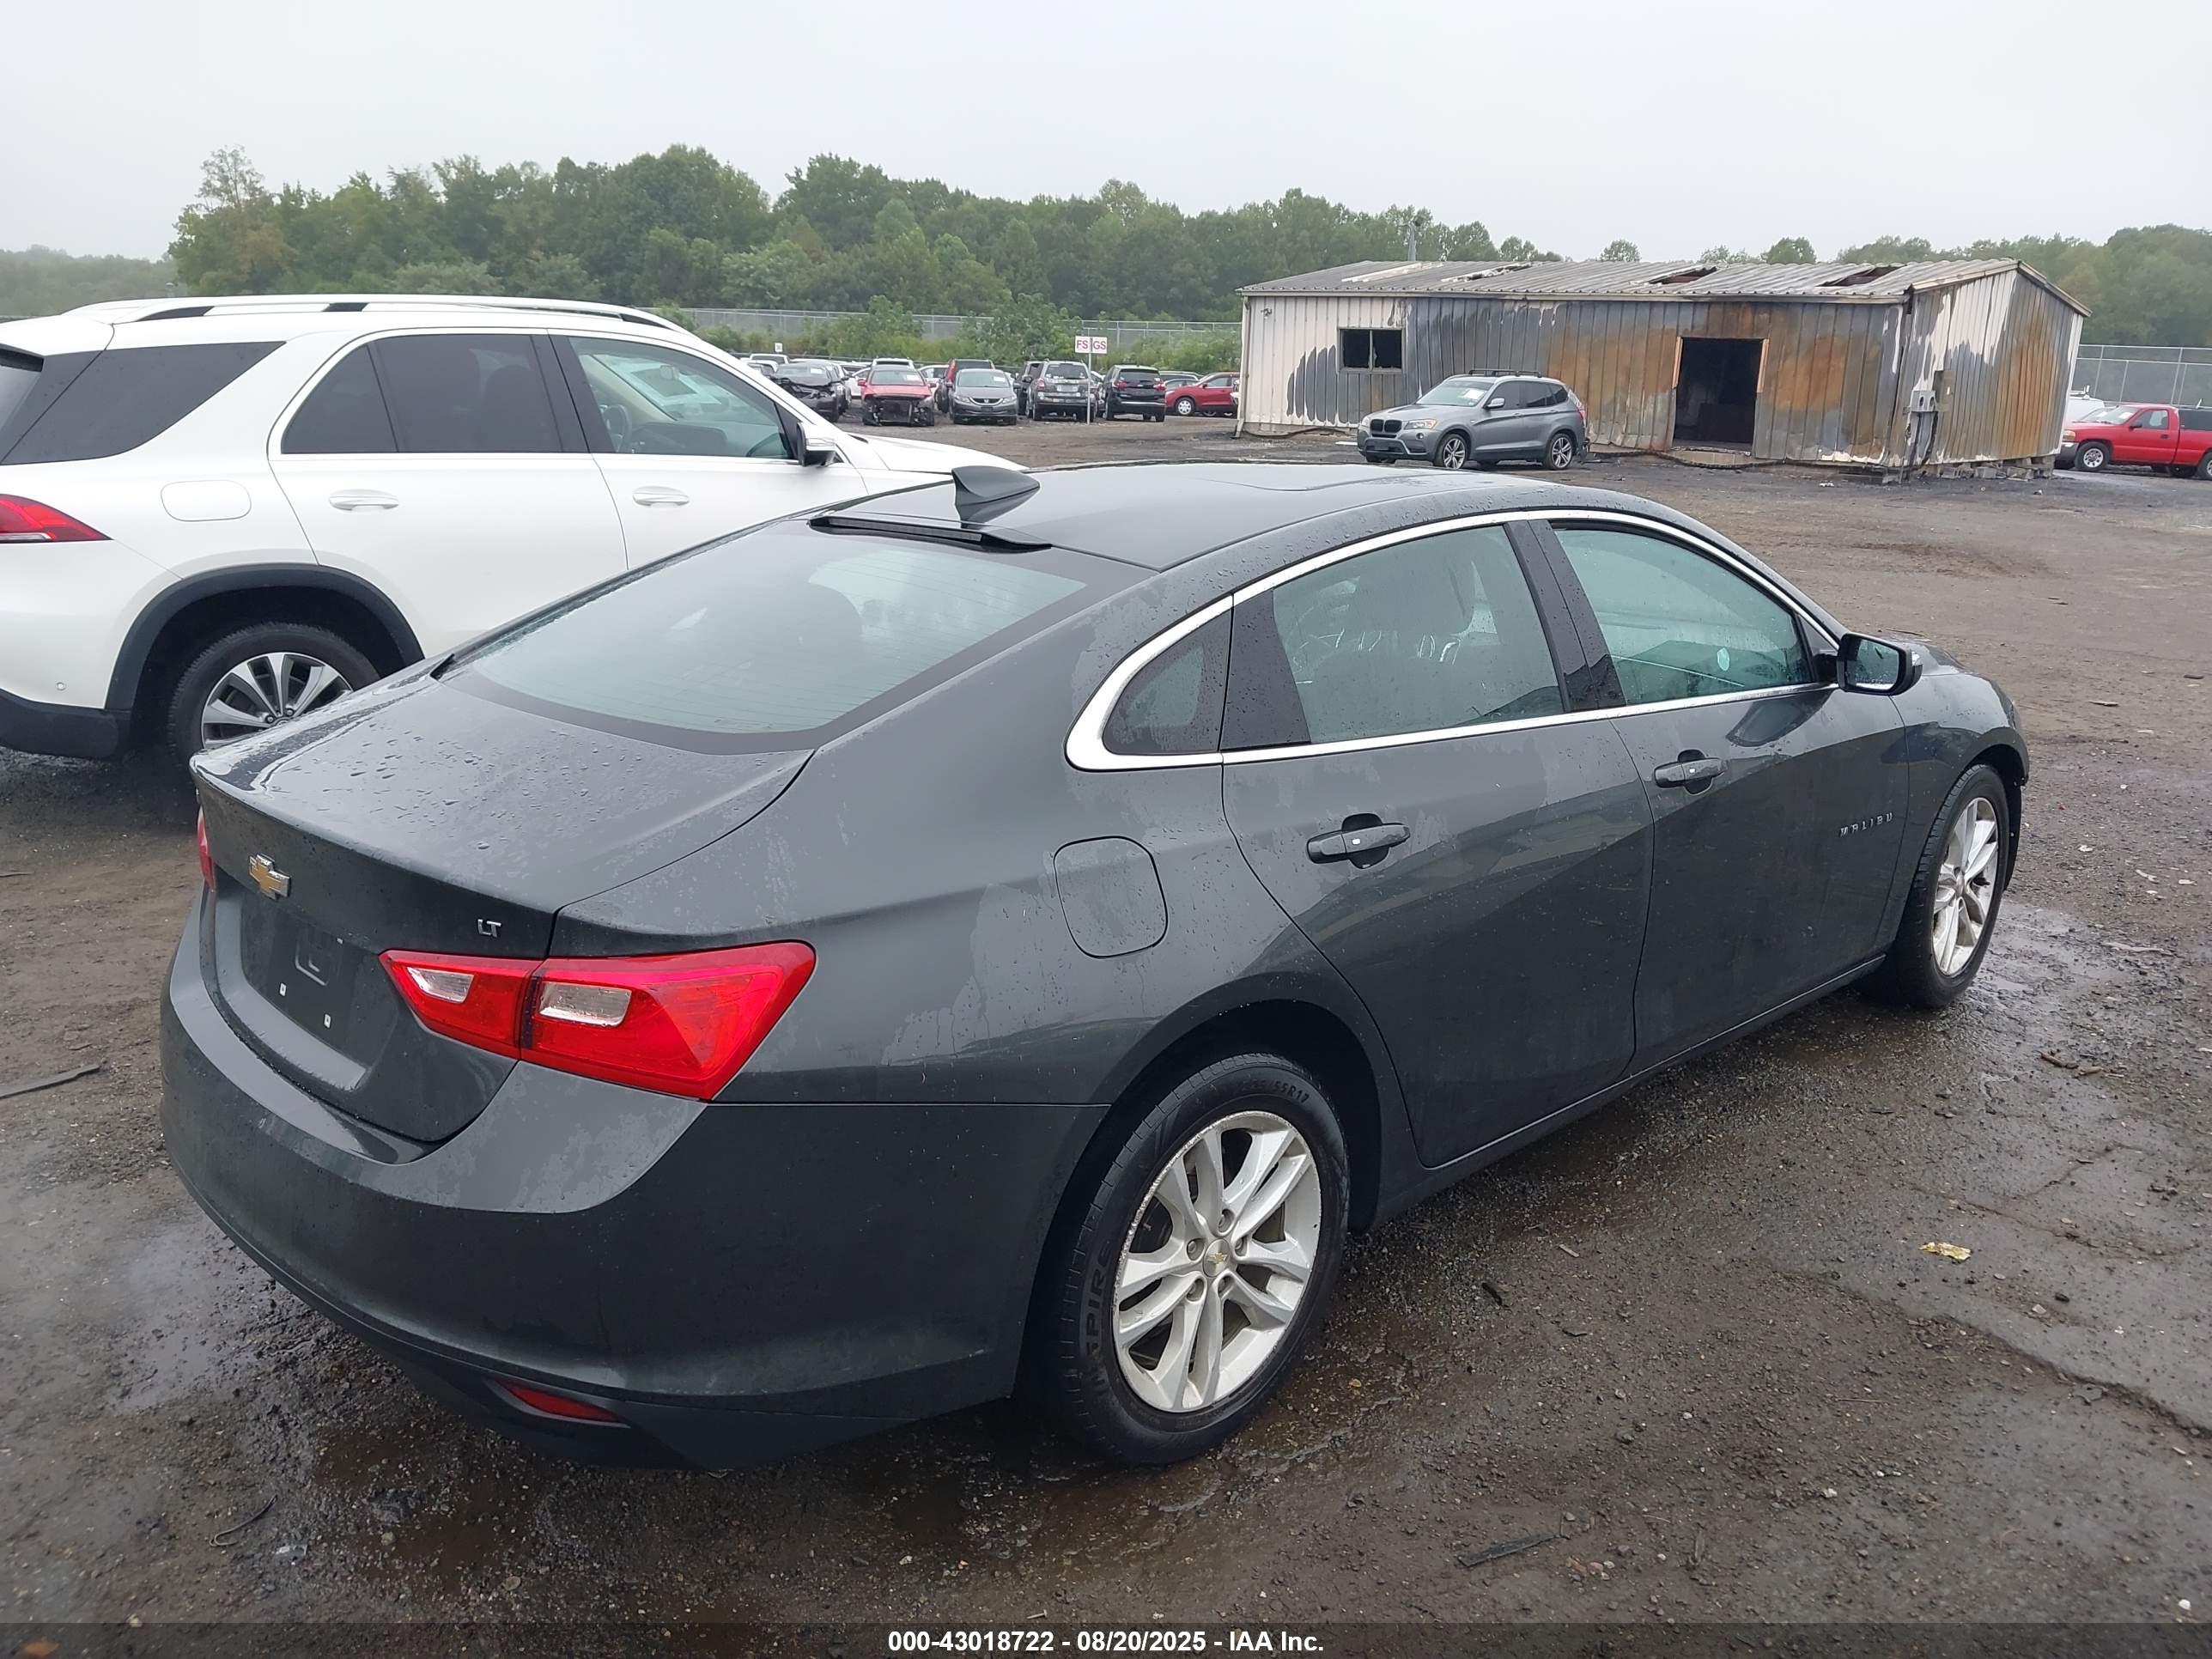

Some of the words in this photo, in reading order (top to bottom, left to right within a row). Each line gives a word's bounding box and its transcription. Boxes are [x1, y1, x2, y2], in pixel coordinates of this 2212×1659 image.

[1077, 340, 1089, 349] FS
[1093, 340, 1107, 350] GS
[1839, 811, 1893, 838] MALIBU
[477, 919, 501, 938] LT
